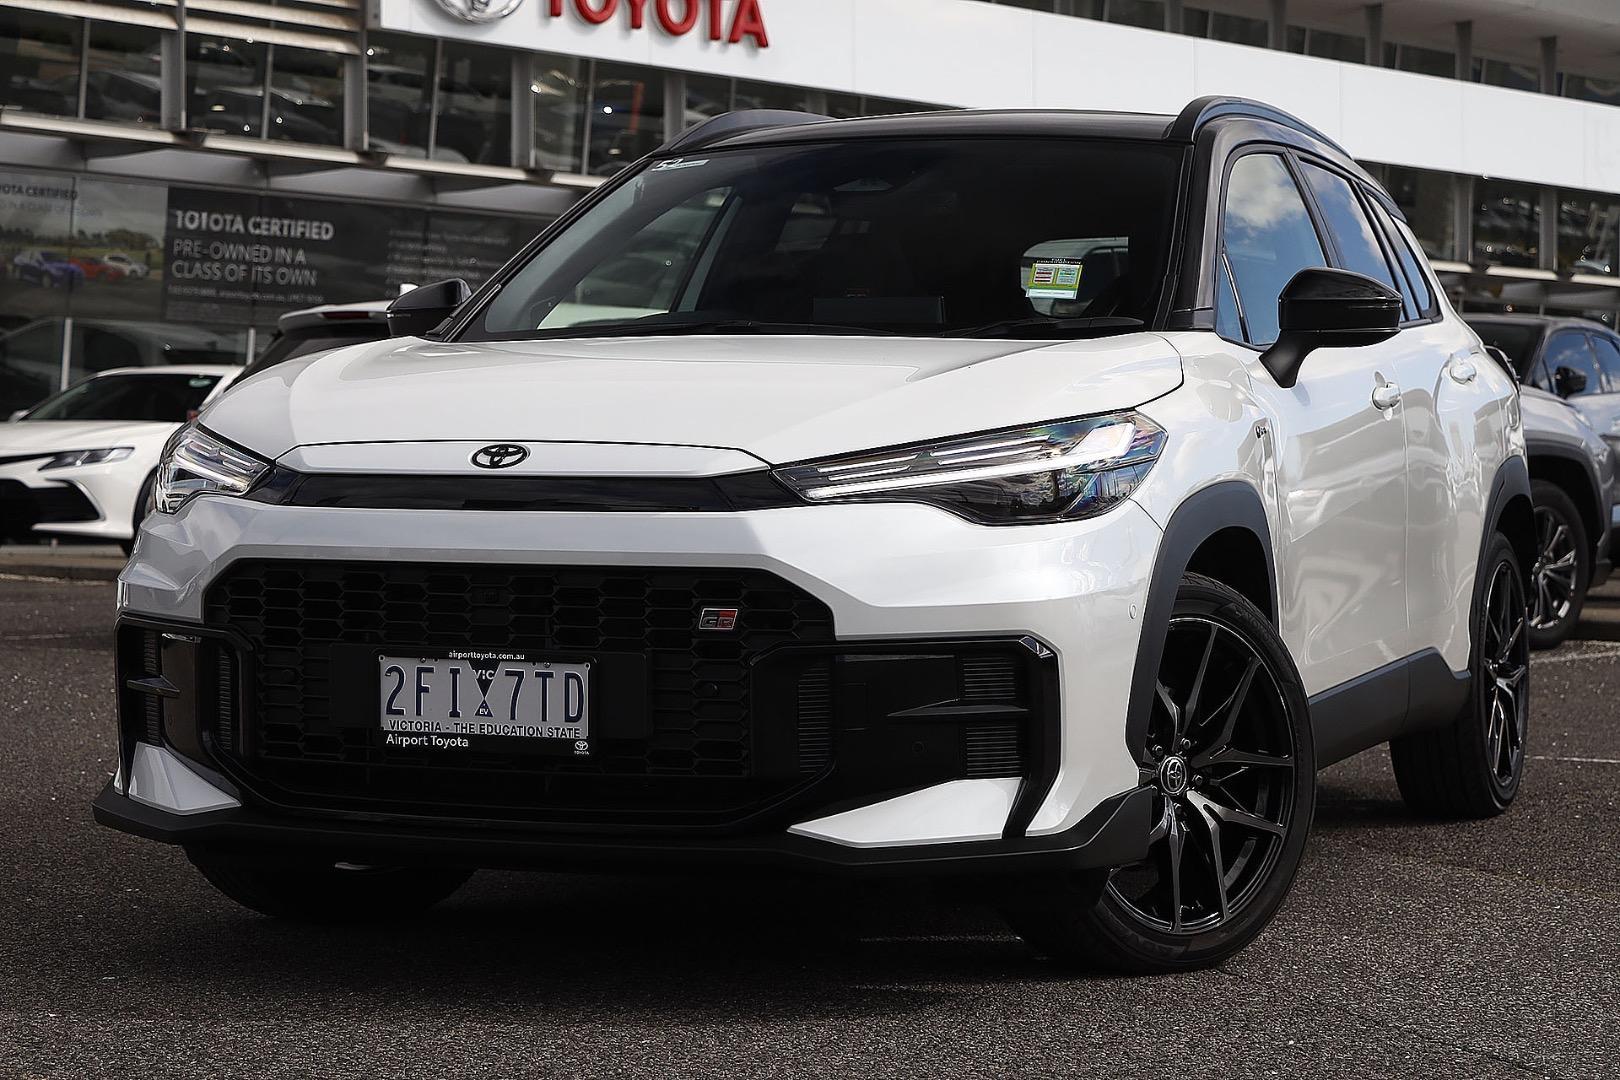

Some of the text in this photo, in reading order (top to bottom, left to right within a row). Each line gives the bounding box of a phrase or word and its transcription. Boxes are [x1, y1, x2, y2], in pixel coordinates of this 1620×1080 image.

[247, 216, 335, 240] CERTIFIED
[173, 239, 307, 264] PRE-OWNED IN A
[172, 260, 318, 287] CLASS OF ITS OWN
[448, 650, 525, 660] airporttoyota.com.au
[472, 669, 495, 680] VIC
[389, 720, 442, 732] VICTORIA
[454, 723, 476, 734] THE
[479, 724, 543, 737] EDUCATION
[547, 727, 581, 739] STATE
[386, 733, 469, 749] Airport Toyota
